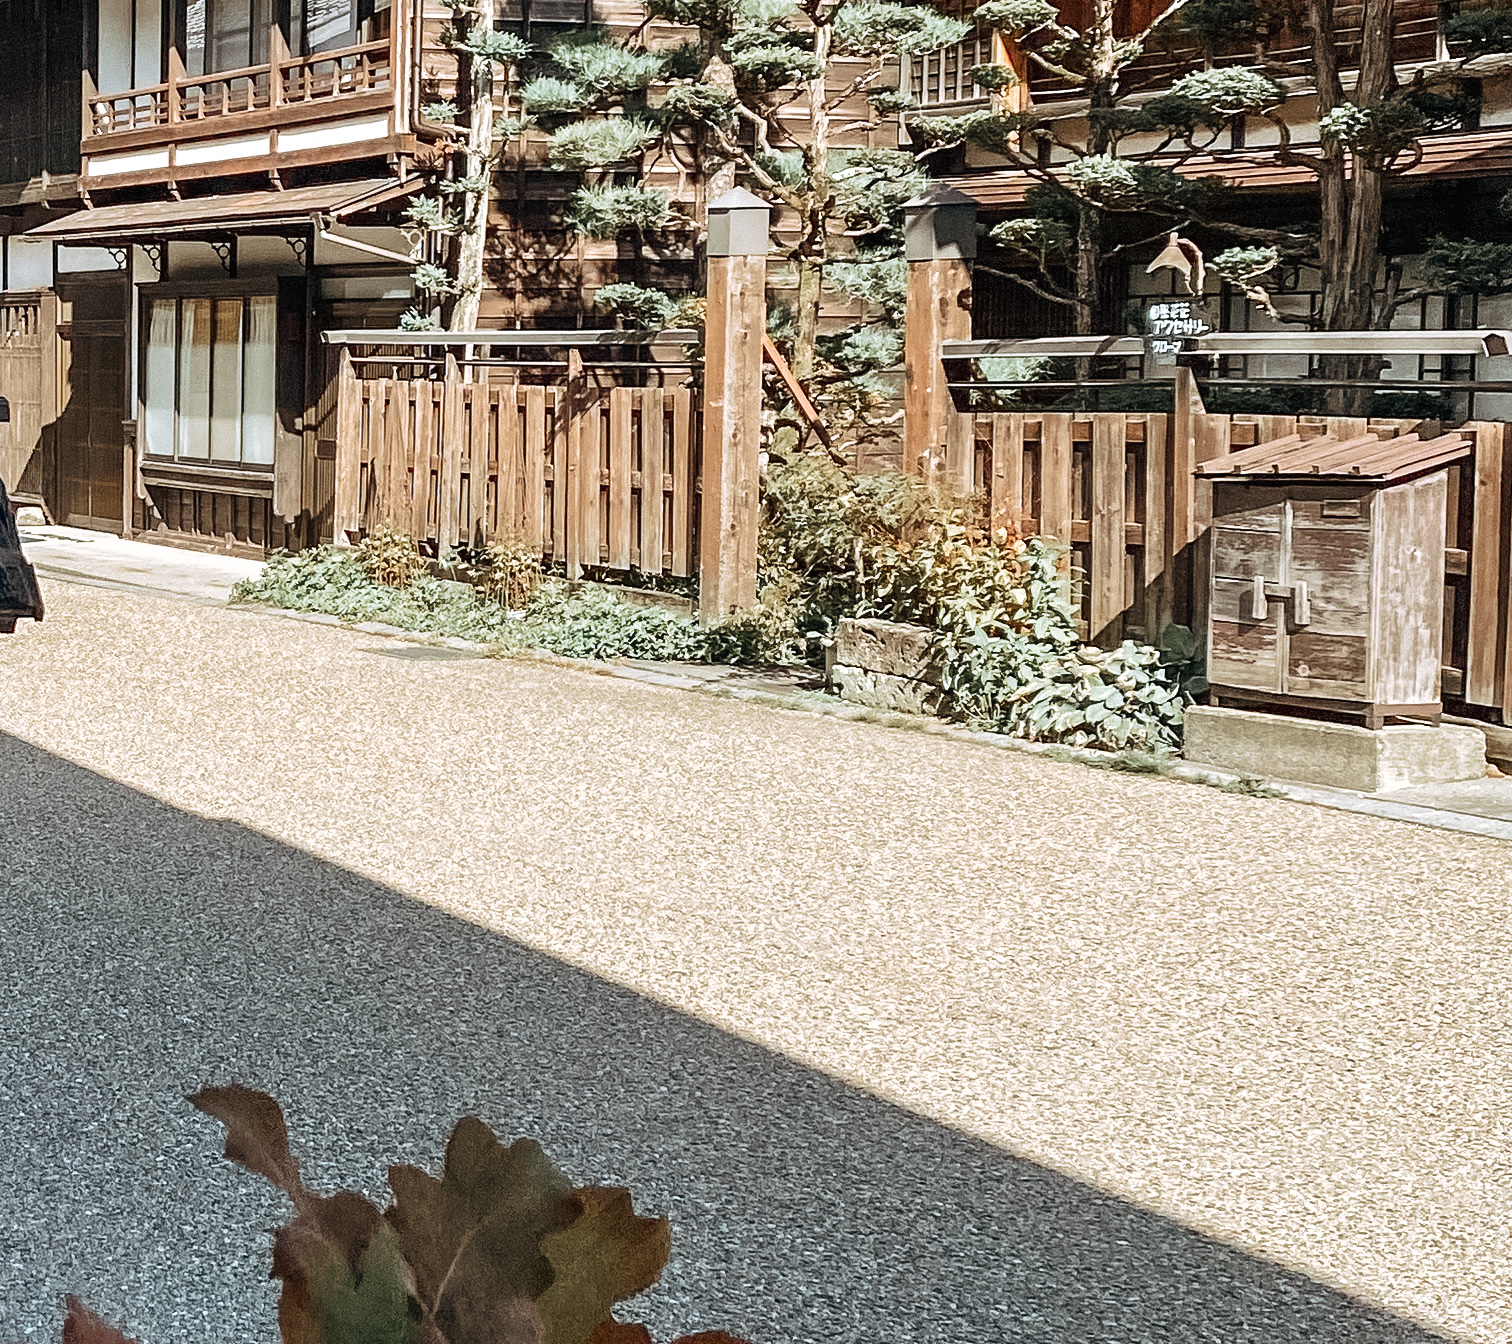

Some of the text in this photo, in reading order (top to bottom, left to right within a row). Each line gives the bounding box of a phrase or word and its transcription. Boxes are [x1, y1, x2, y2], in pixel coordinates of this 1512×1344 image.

[1153, 318, 1209, 335] アクセサリー
